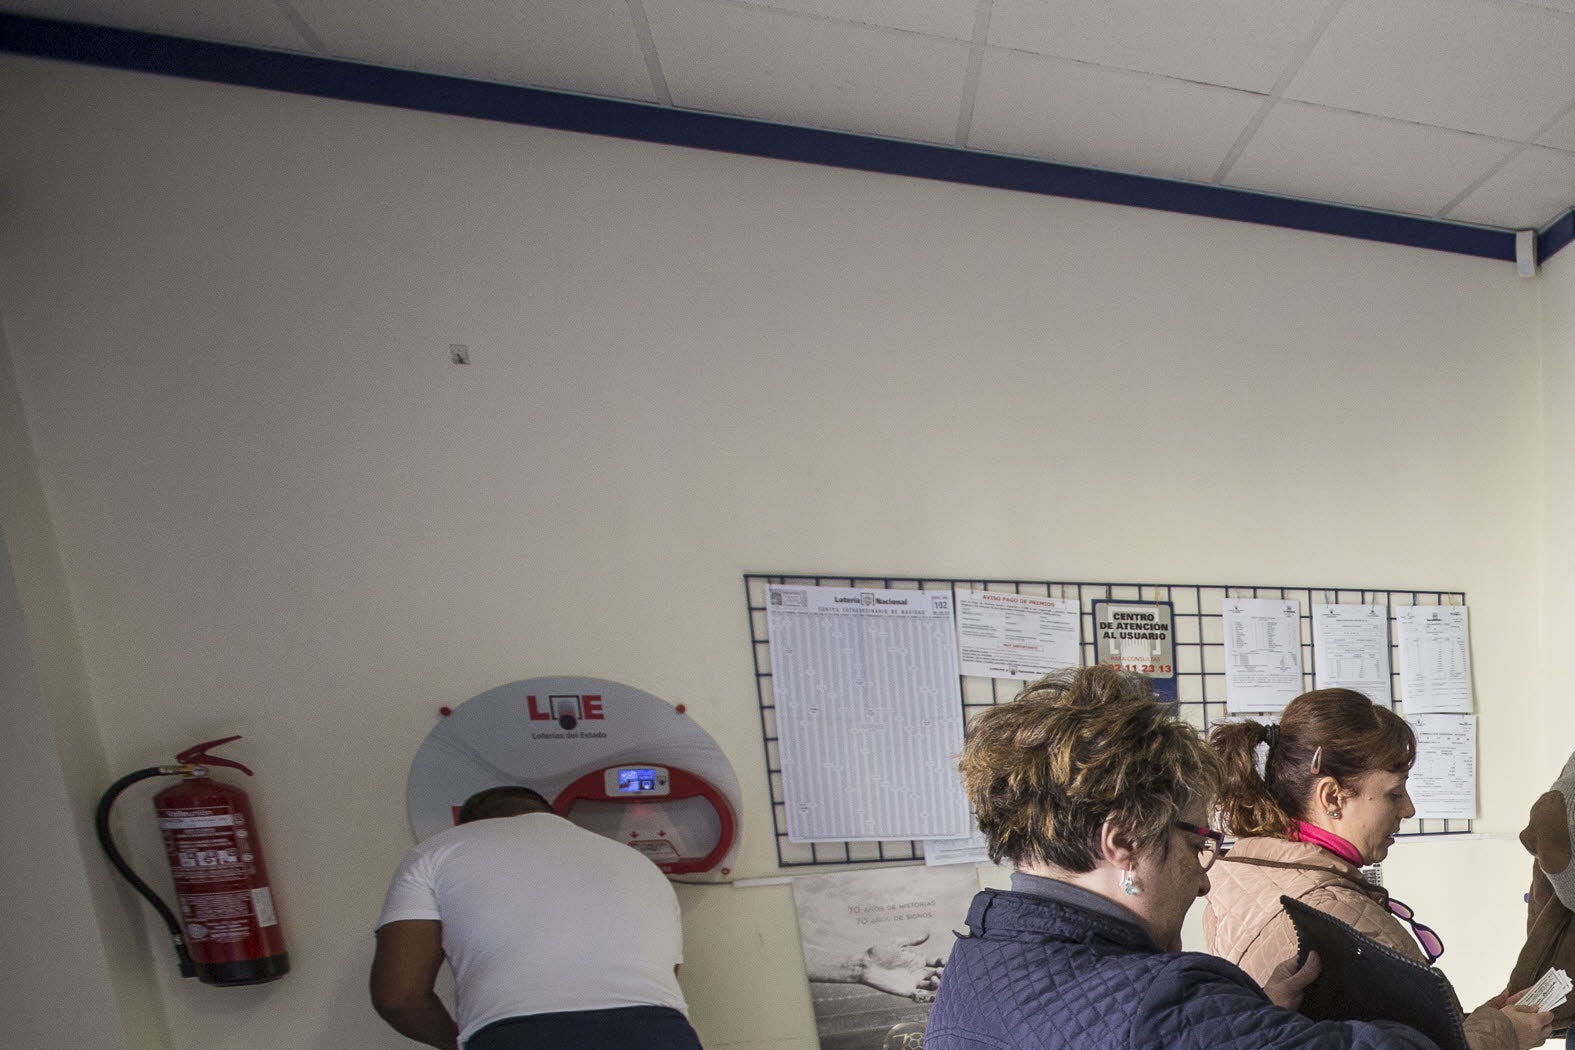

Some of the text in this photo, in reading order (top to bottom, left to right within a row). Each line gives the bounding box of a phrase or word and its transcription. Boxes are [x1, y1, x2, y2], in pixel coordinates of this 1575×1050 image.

[876, 597, 908, 605] Nacional
[934, 601, 948, 609] 102
[1028, 599, 1055, 607] PREMIOS
[1113, 613, 1155, 621] CENTRO
[1099, 621, 1168, 631] DE ATENCIÓN
[1103, 632, 1166, 640] AL USUARIO
[1159, 665, 1171, 673] 13
[899, 900, 936, 910] HISTORIAS
